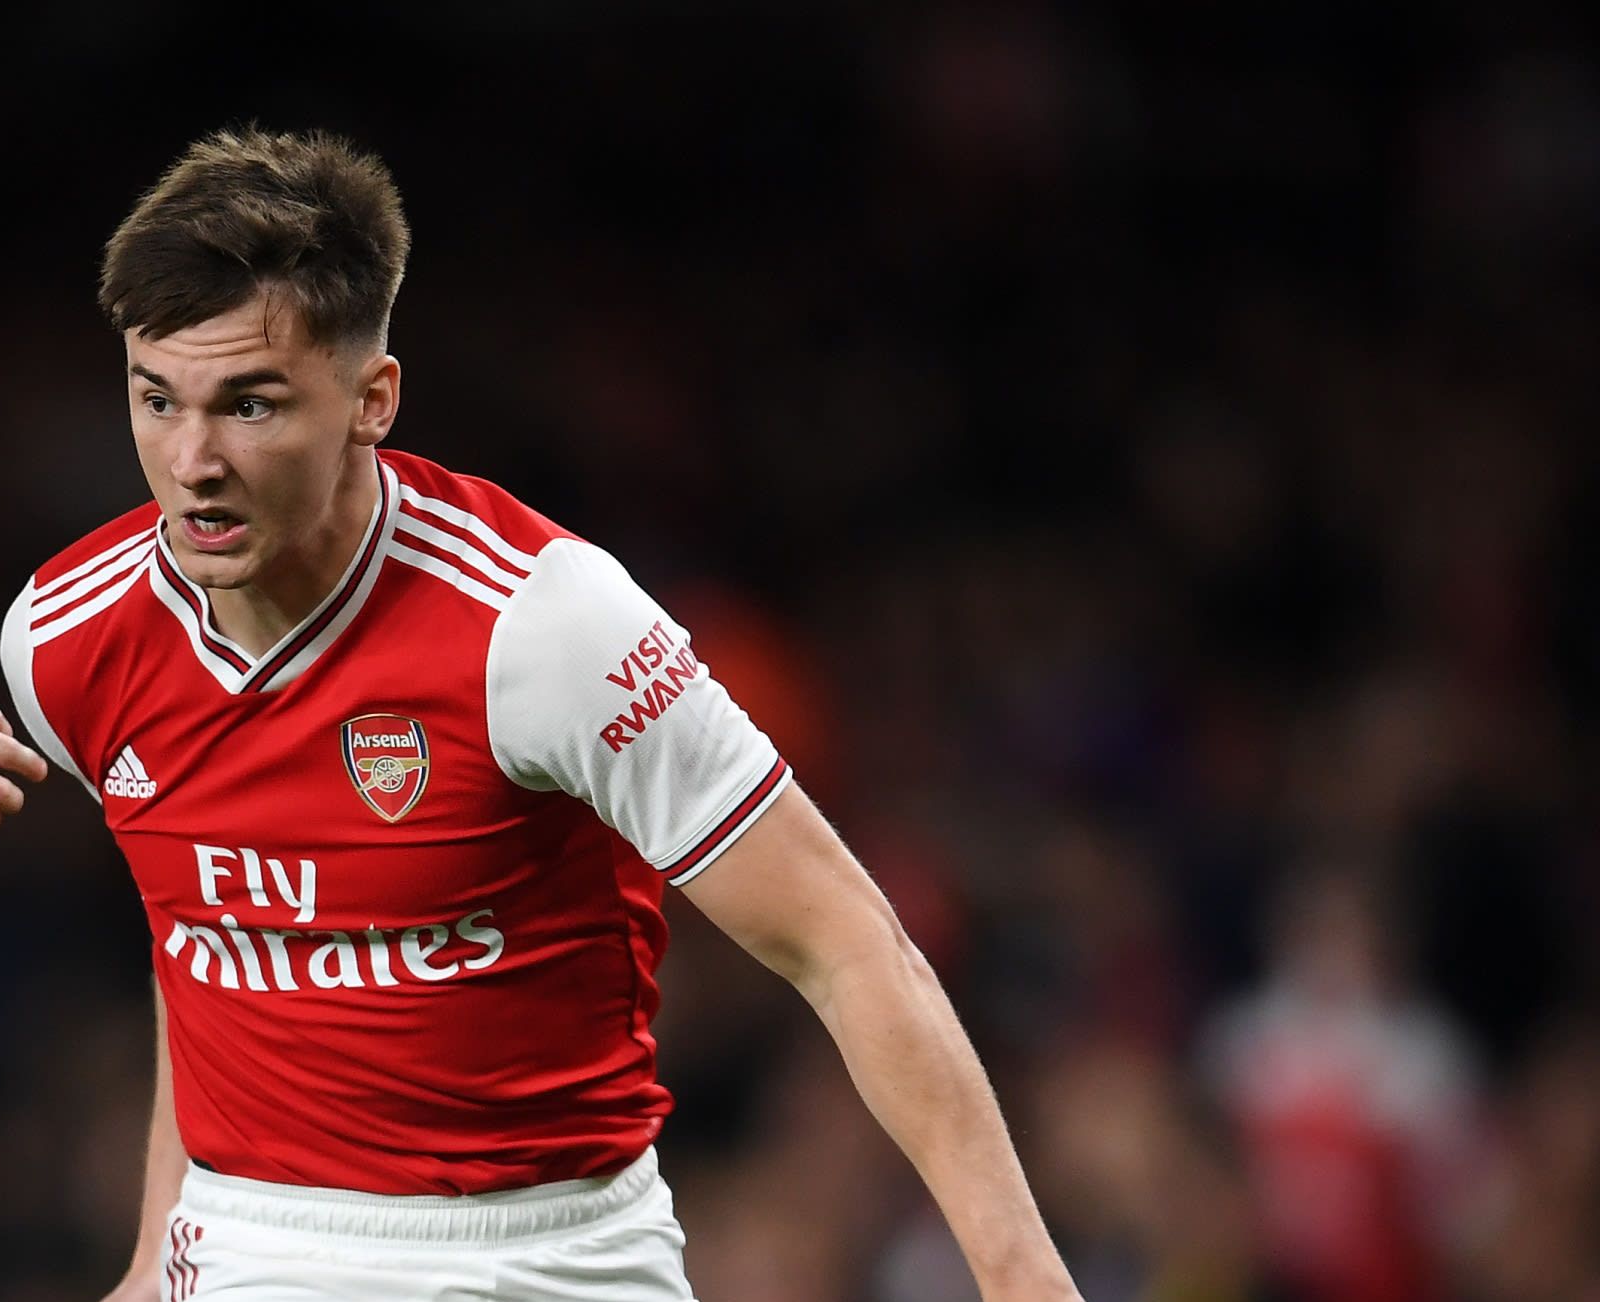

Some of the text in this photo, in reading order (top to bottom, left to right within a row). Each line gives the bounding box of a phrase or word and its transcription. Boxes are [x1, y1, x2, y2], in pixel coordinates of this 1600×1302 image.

[605, 620, 675, 692] VISIT
[600, 646, 698, 753] RWAND
[353, 731, 416, 748] Arsenal
[105, 777, 157, 799] adidas
[193, 843, 316, 923] Fly
[165, 908, 505, 991] mirates
